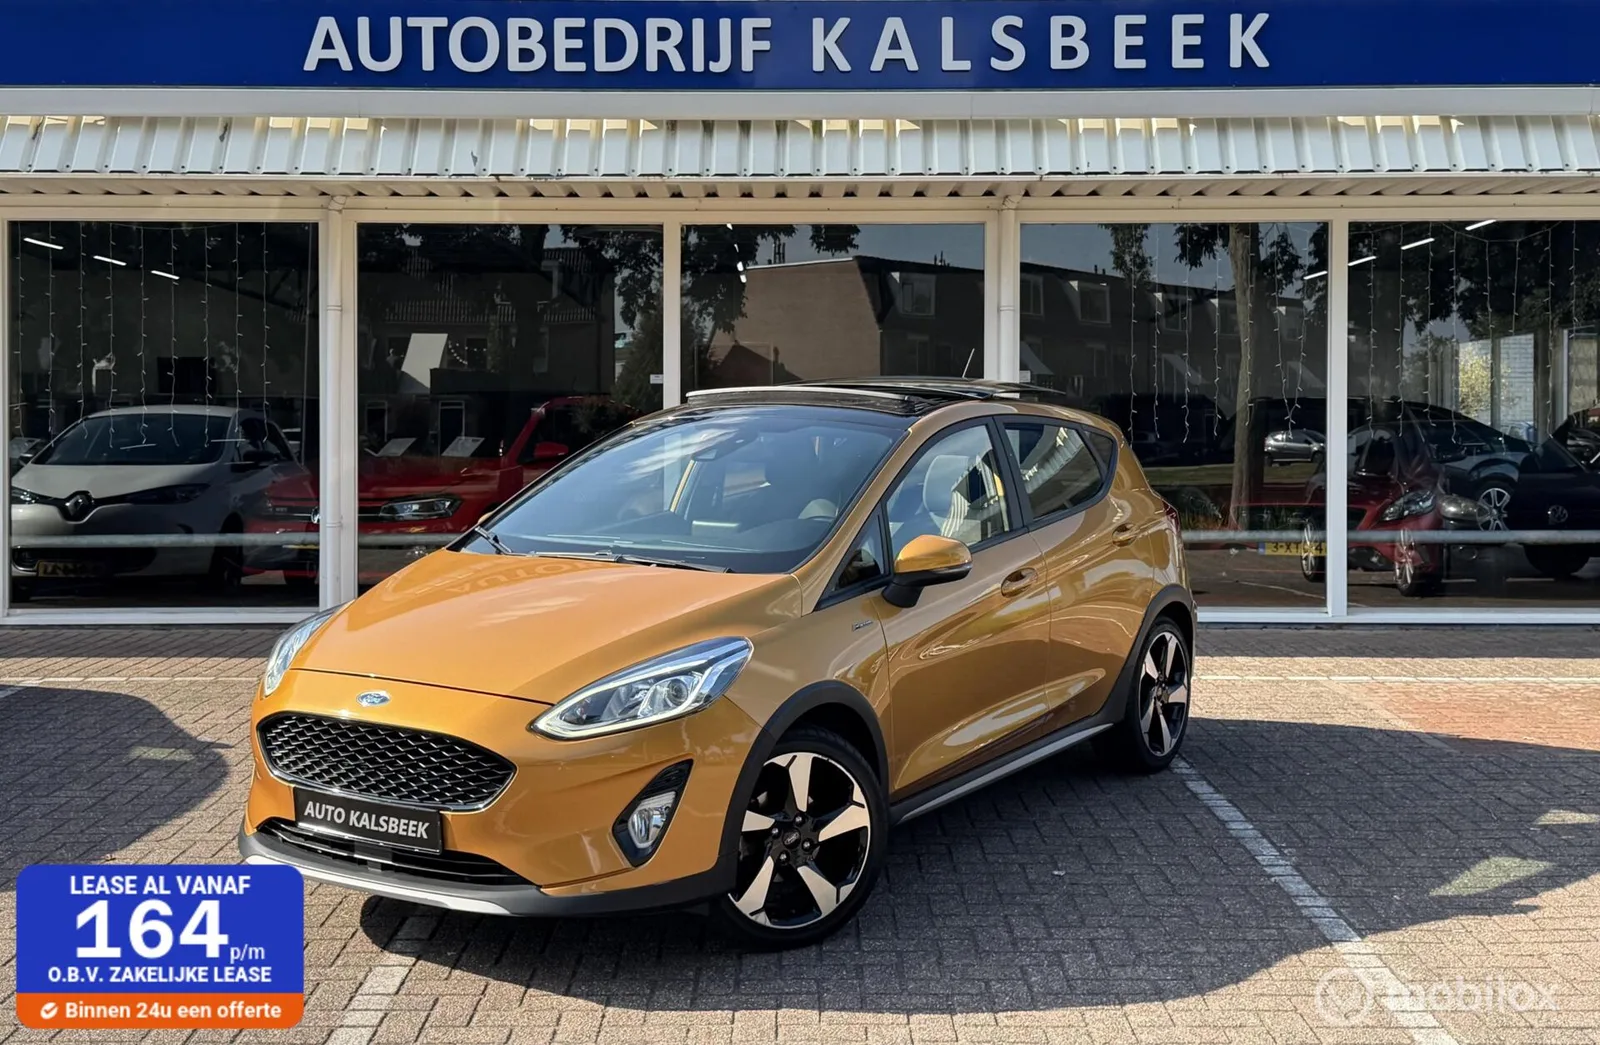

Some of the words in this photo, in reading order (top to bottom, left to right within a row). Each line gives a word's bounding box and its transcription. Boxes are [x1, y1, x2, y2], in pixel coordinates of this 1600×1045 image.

[303, 16, 772, 73] AUTOBEDRIJF
[812, 13, 1270, 72] KALSBEEK
[304, 801, 346, 824] AUTO
[349, 810, 430, 839] KALSBEEK
